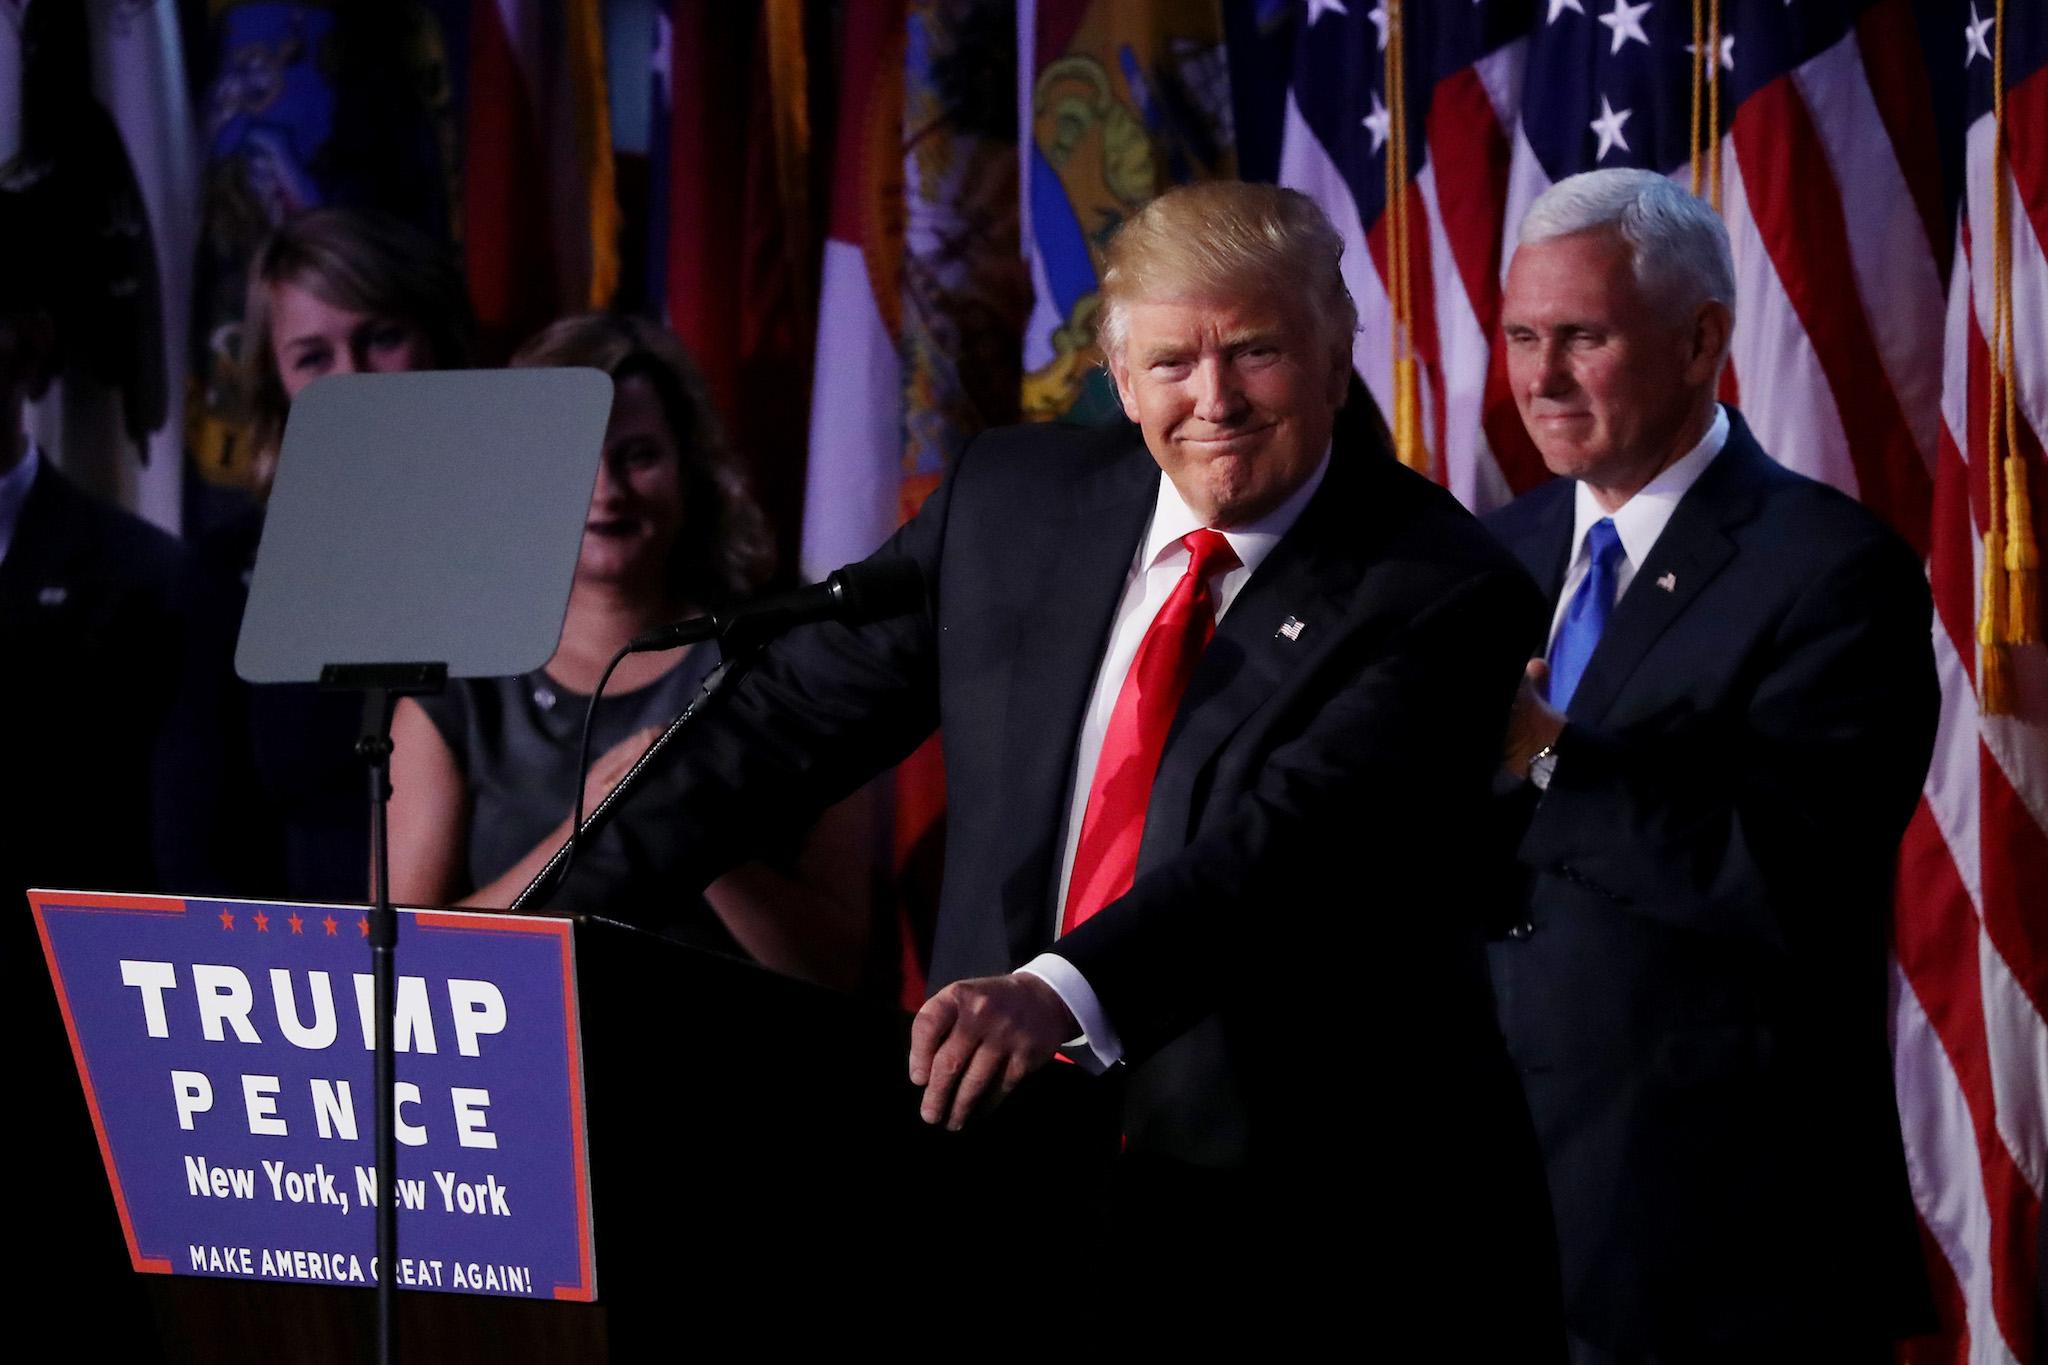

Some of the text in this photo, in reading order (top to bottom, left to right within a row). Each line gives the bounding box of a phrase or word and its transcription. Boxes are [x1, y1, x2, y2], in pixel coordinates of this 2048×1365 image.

[119, 959, 507, 1057] TRUMP
[170, 1070, 498, 1150] PENCE
[184, 1155, 255, 1200] New
[261, 1160, 349, 1216] York,
[432, 1170, 512, 1217] York
[189, 1245, 532, 1293] MAKE AMERICA EAT AGAIN!
